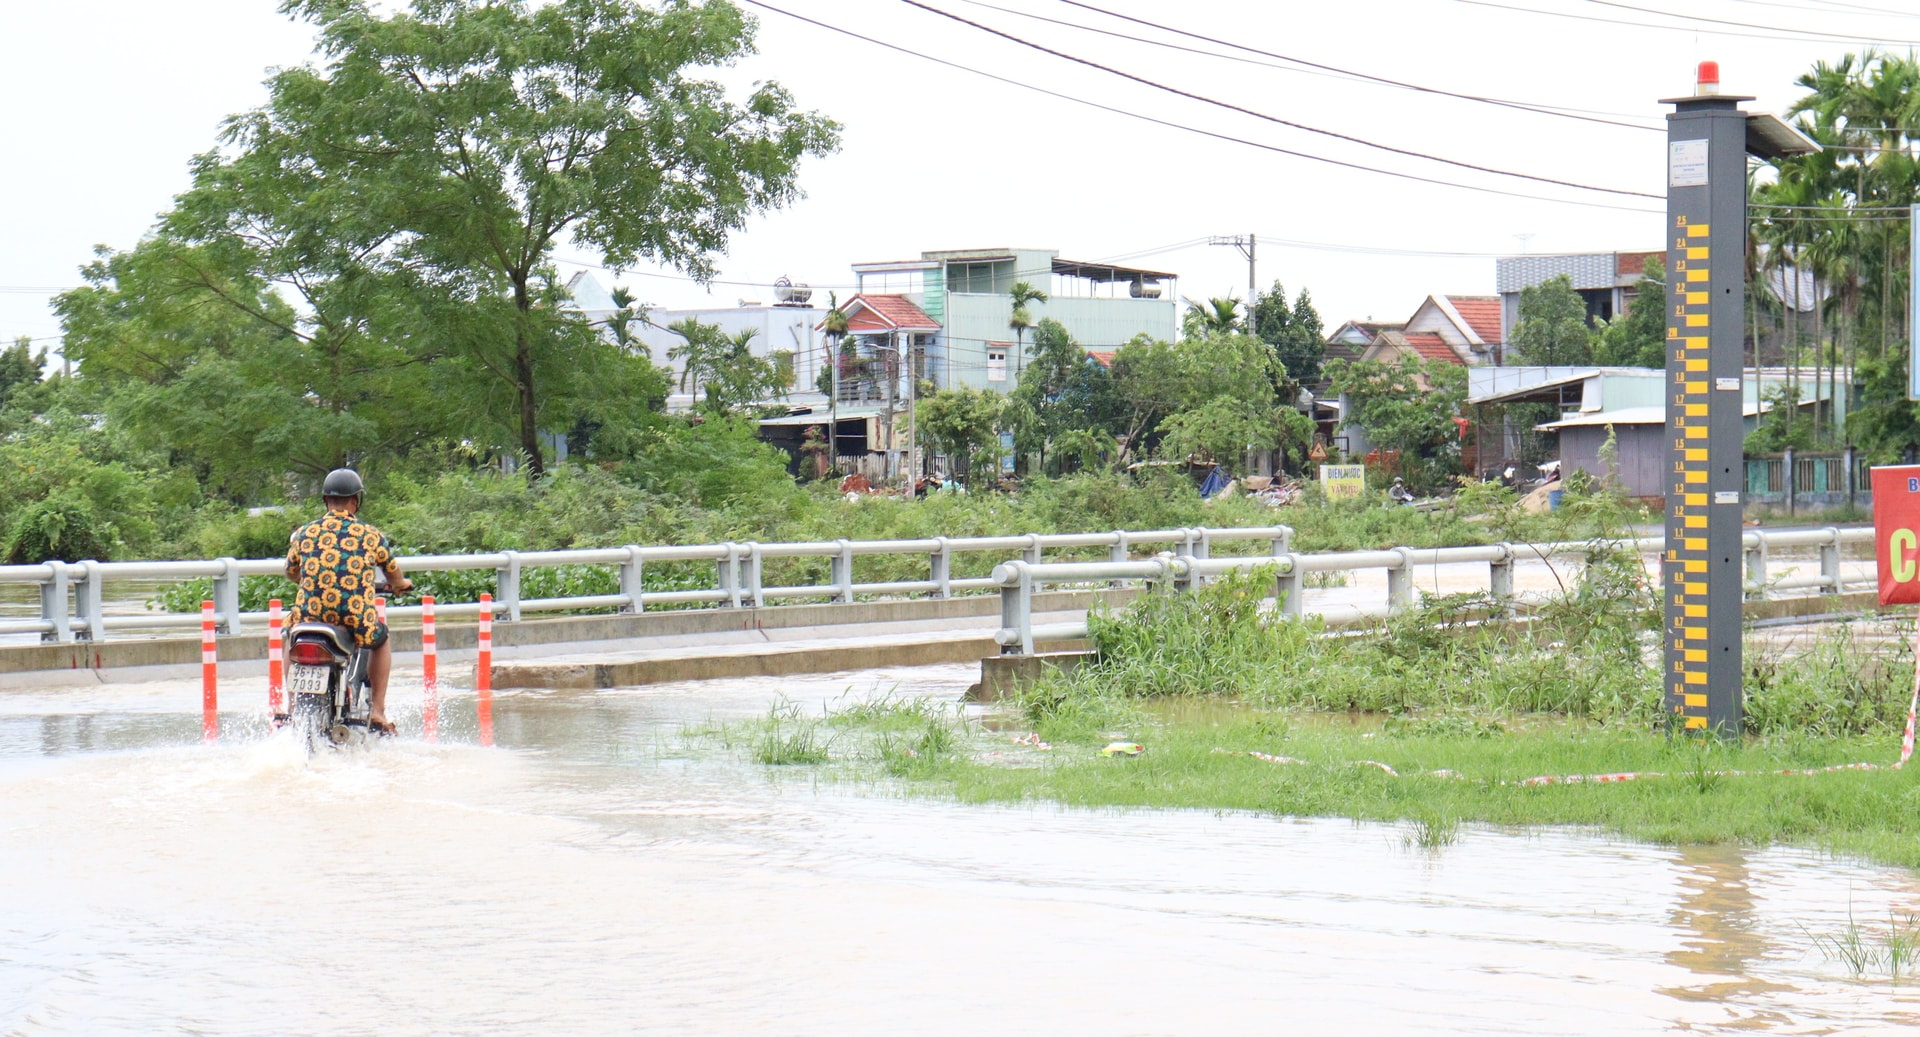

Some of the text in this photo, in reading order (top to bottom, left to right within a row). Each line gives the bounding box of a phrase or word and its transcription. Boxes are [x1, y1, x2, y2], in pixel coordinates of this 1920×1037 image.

[1676, 216, 1686, 225] 2.5
[1676, 238, 1686, 248] 2.4
[1676, 260, 1686, 270] 2.3
[1676, 282, 1685, 292] 2.2
[1676, 305, 1684, 314] 2.1
[1675, 394, 1684, 404] 1.7
[1675, 439, 1684, 448] 1.5
[1675, 483, 1684, 493] 1.3
[1675, 506, 1684, 515] 1.2
[1675, 528, 1683, 537] 1.1
[1674, 617, 1684, 626] 0.7
[292, 679, 321, 690] 7093
[1674, 706, 1684, 716] 03
